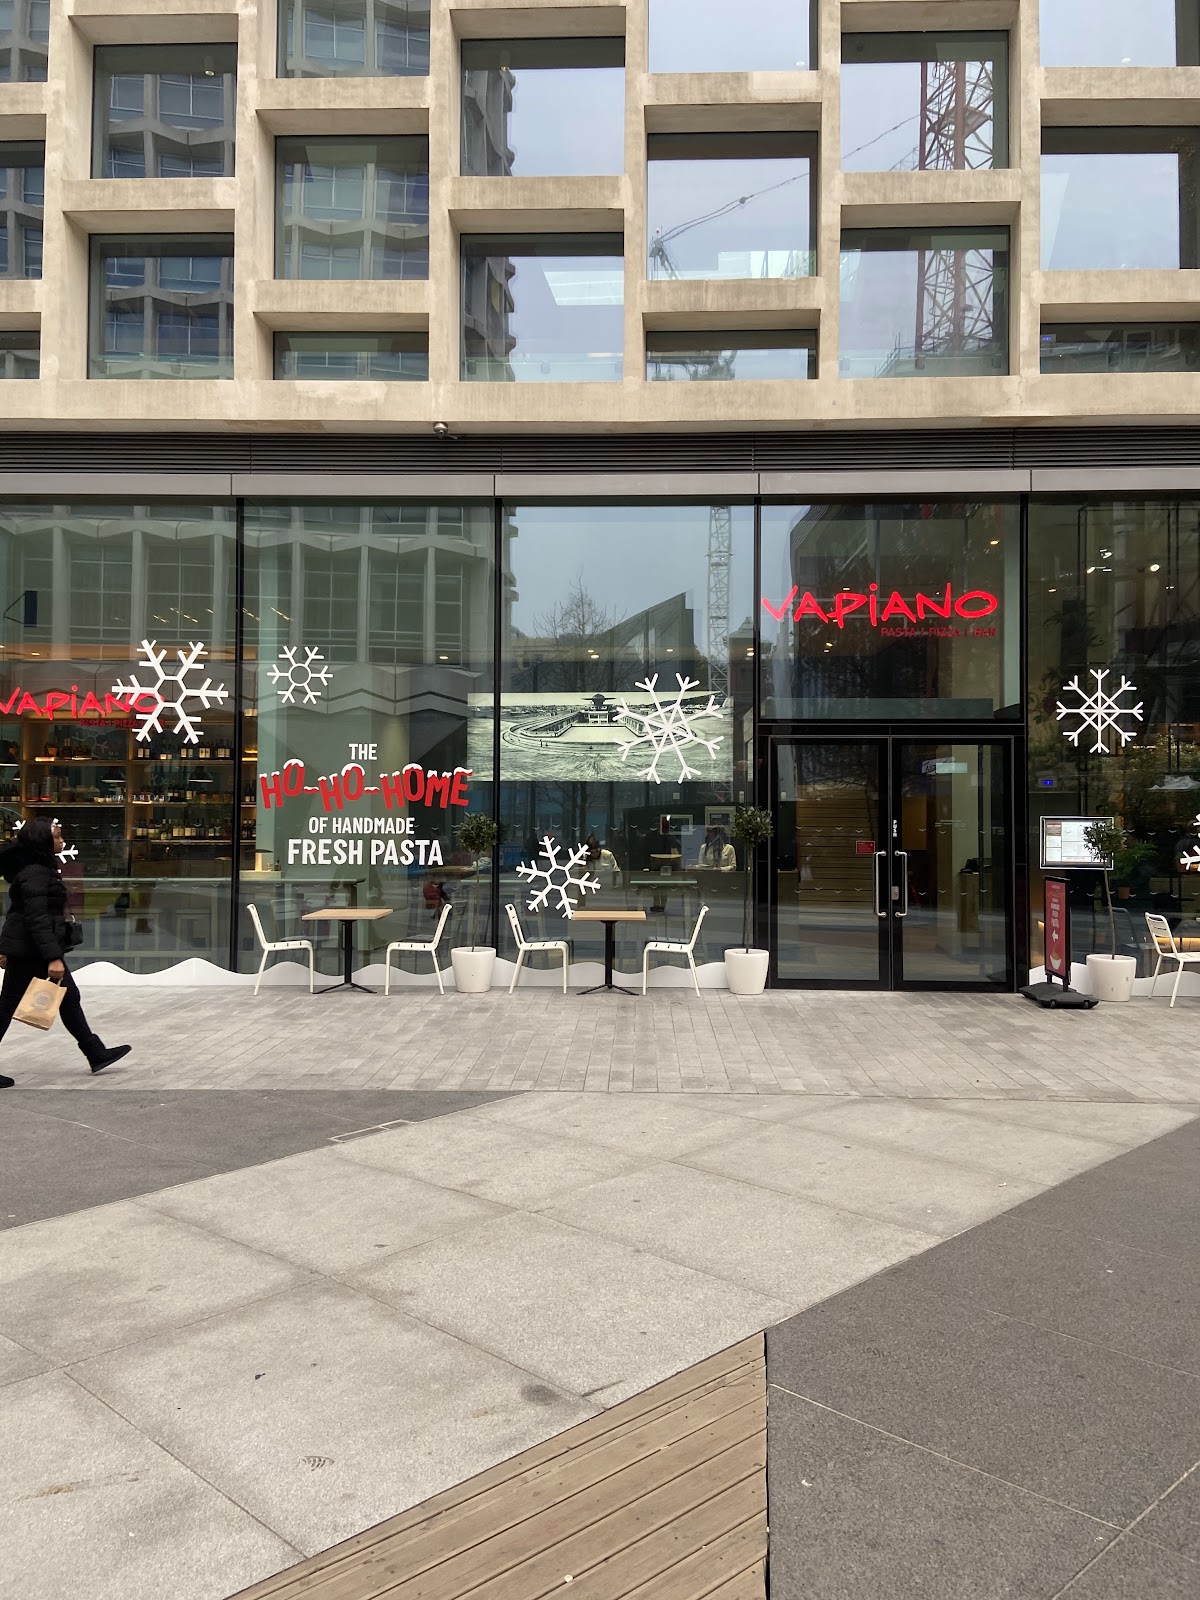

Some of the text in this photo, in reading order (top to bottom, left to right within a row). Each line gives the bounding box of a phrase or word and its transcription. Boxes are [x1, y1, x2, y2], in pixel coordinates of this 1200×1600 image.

[880, 627, 917, 637] PASTA
[928, 627, 961, 637] PIZZA
[973, 627, 997, 637] BAR
[349, 743, 378, 760] THE
[309, 817, 415, 835] OF HANDMADE
[287, 839, 444, 866] FRESH PASTA
